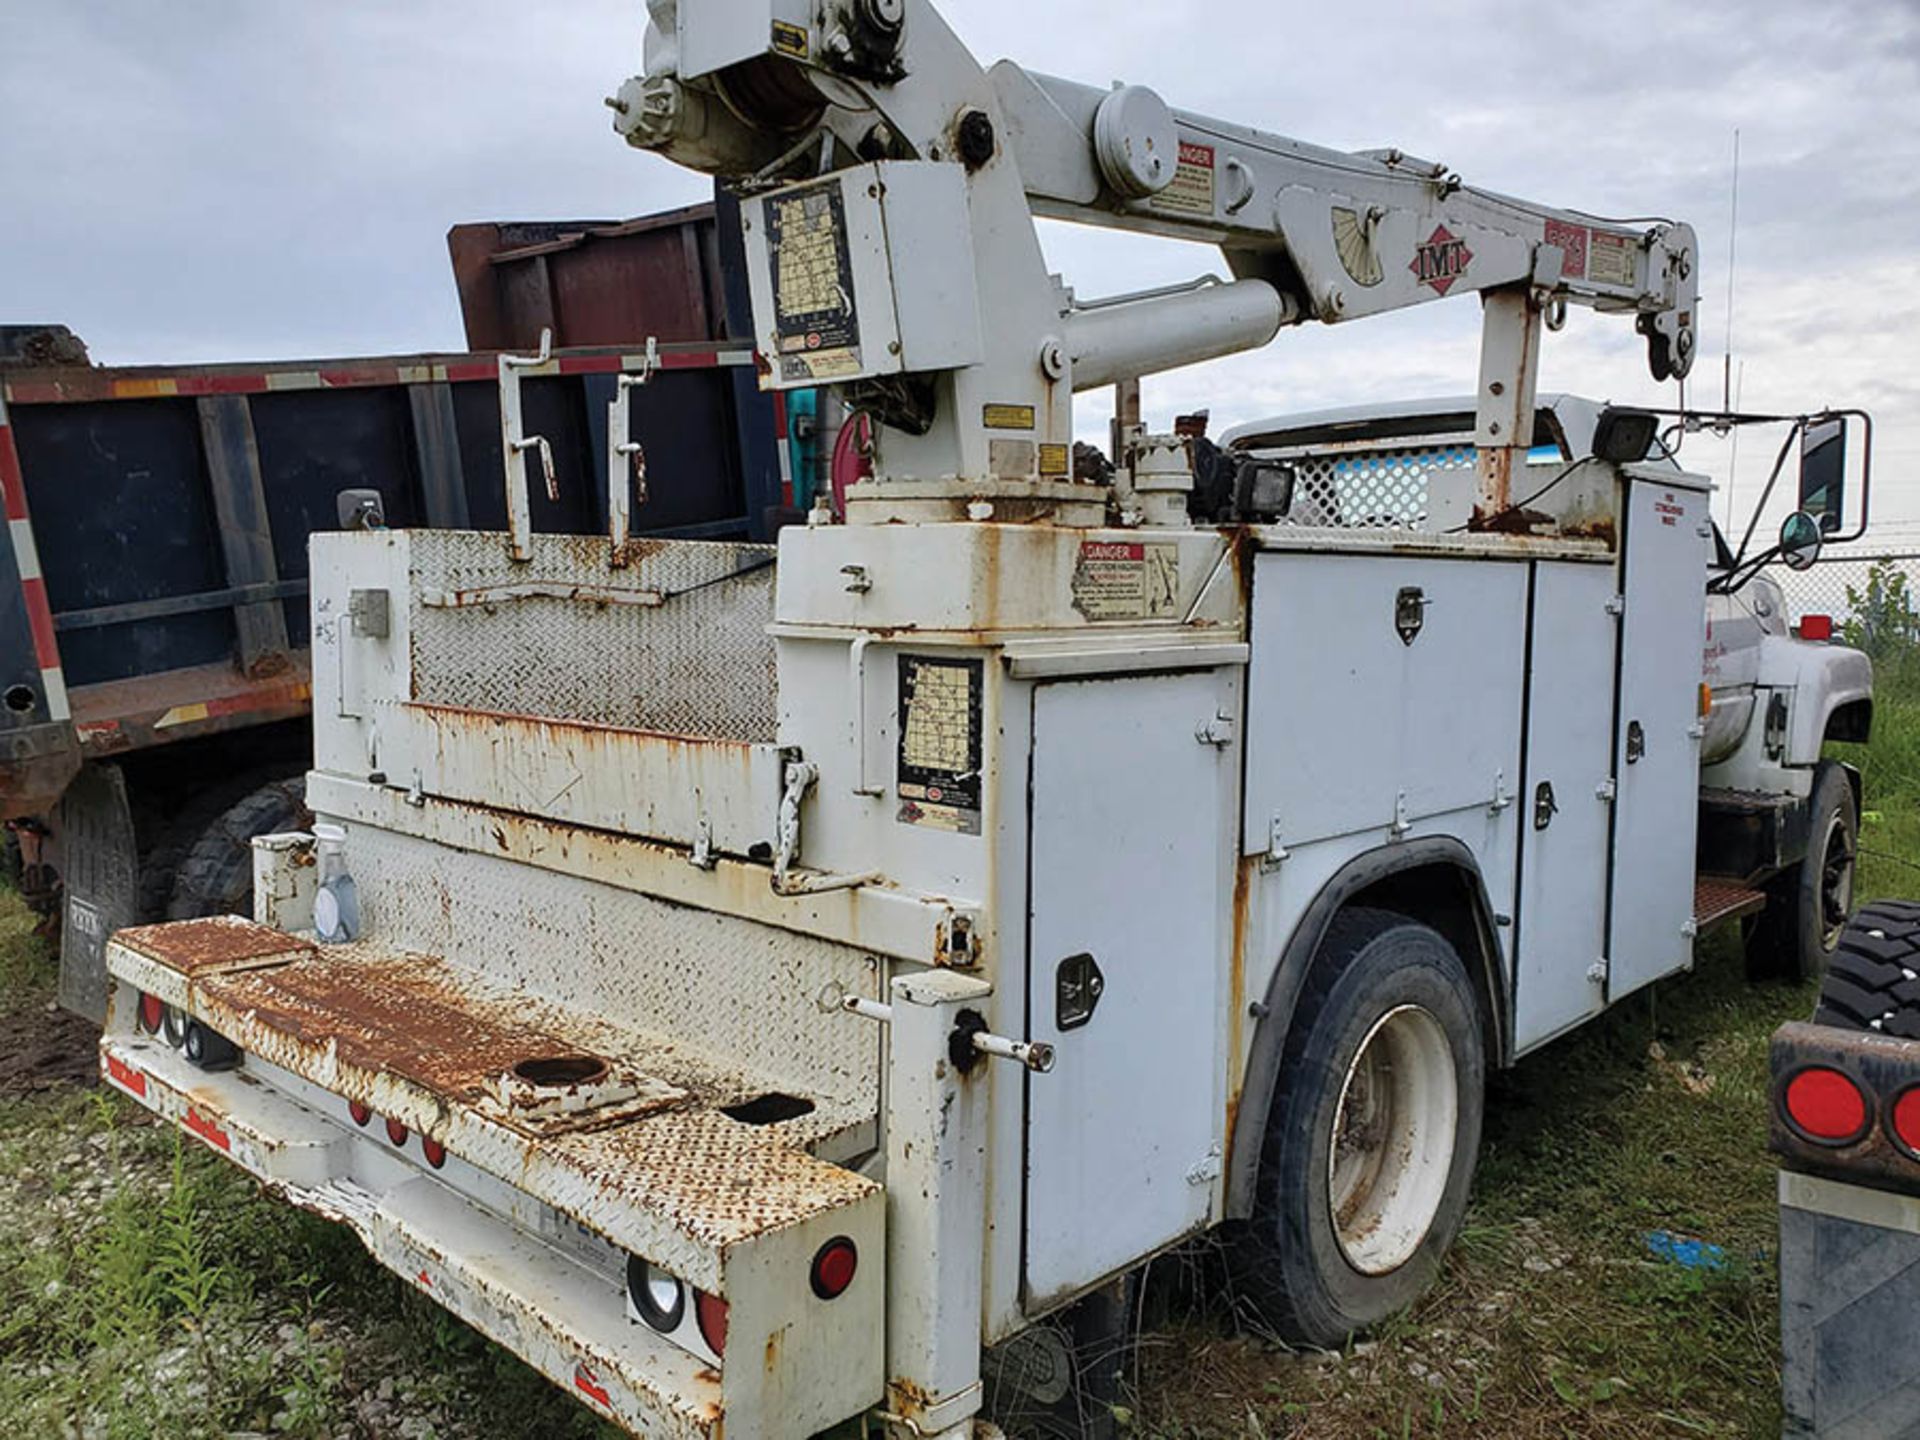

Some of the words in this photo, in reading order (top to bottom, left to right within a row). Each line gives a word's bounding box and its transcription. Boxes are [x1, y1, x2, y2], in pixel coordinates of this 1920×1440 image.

[1178, 147, 1210, 165] ANGER
[1417, 239, 1465, 282] IMT
[1086, 545, 1132, 559] DANGER
